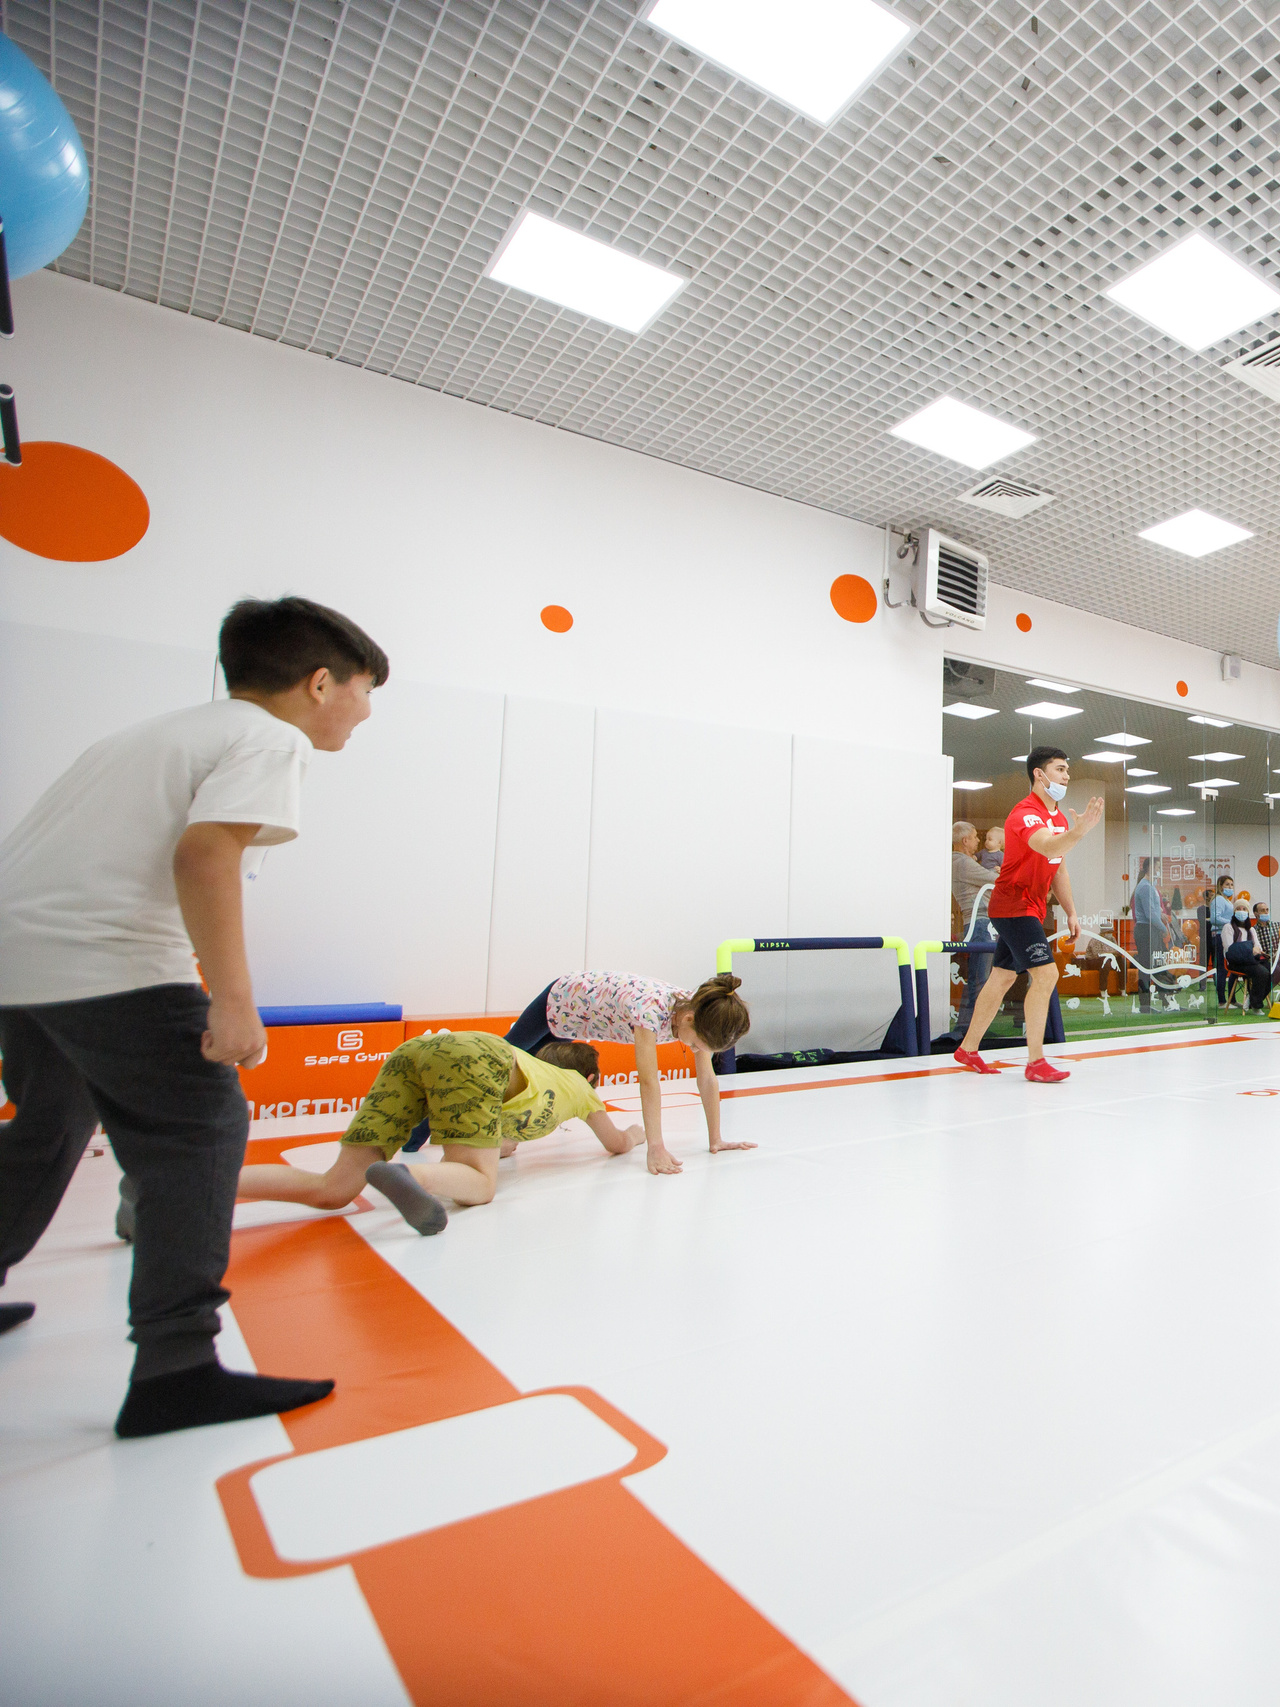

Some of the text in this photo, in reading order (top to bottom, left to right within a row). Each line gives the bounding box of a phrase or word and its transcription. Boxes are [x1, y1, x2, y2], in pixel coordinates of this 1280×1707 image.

[945, 611, 975, 623] VOLCANO
[304, 1055, 350, 1066] Safe
[603, 1067, 690, 1086] КРЕЫШ
[259, 1097, 367, 1120] КРЕПЫ
